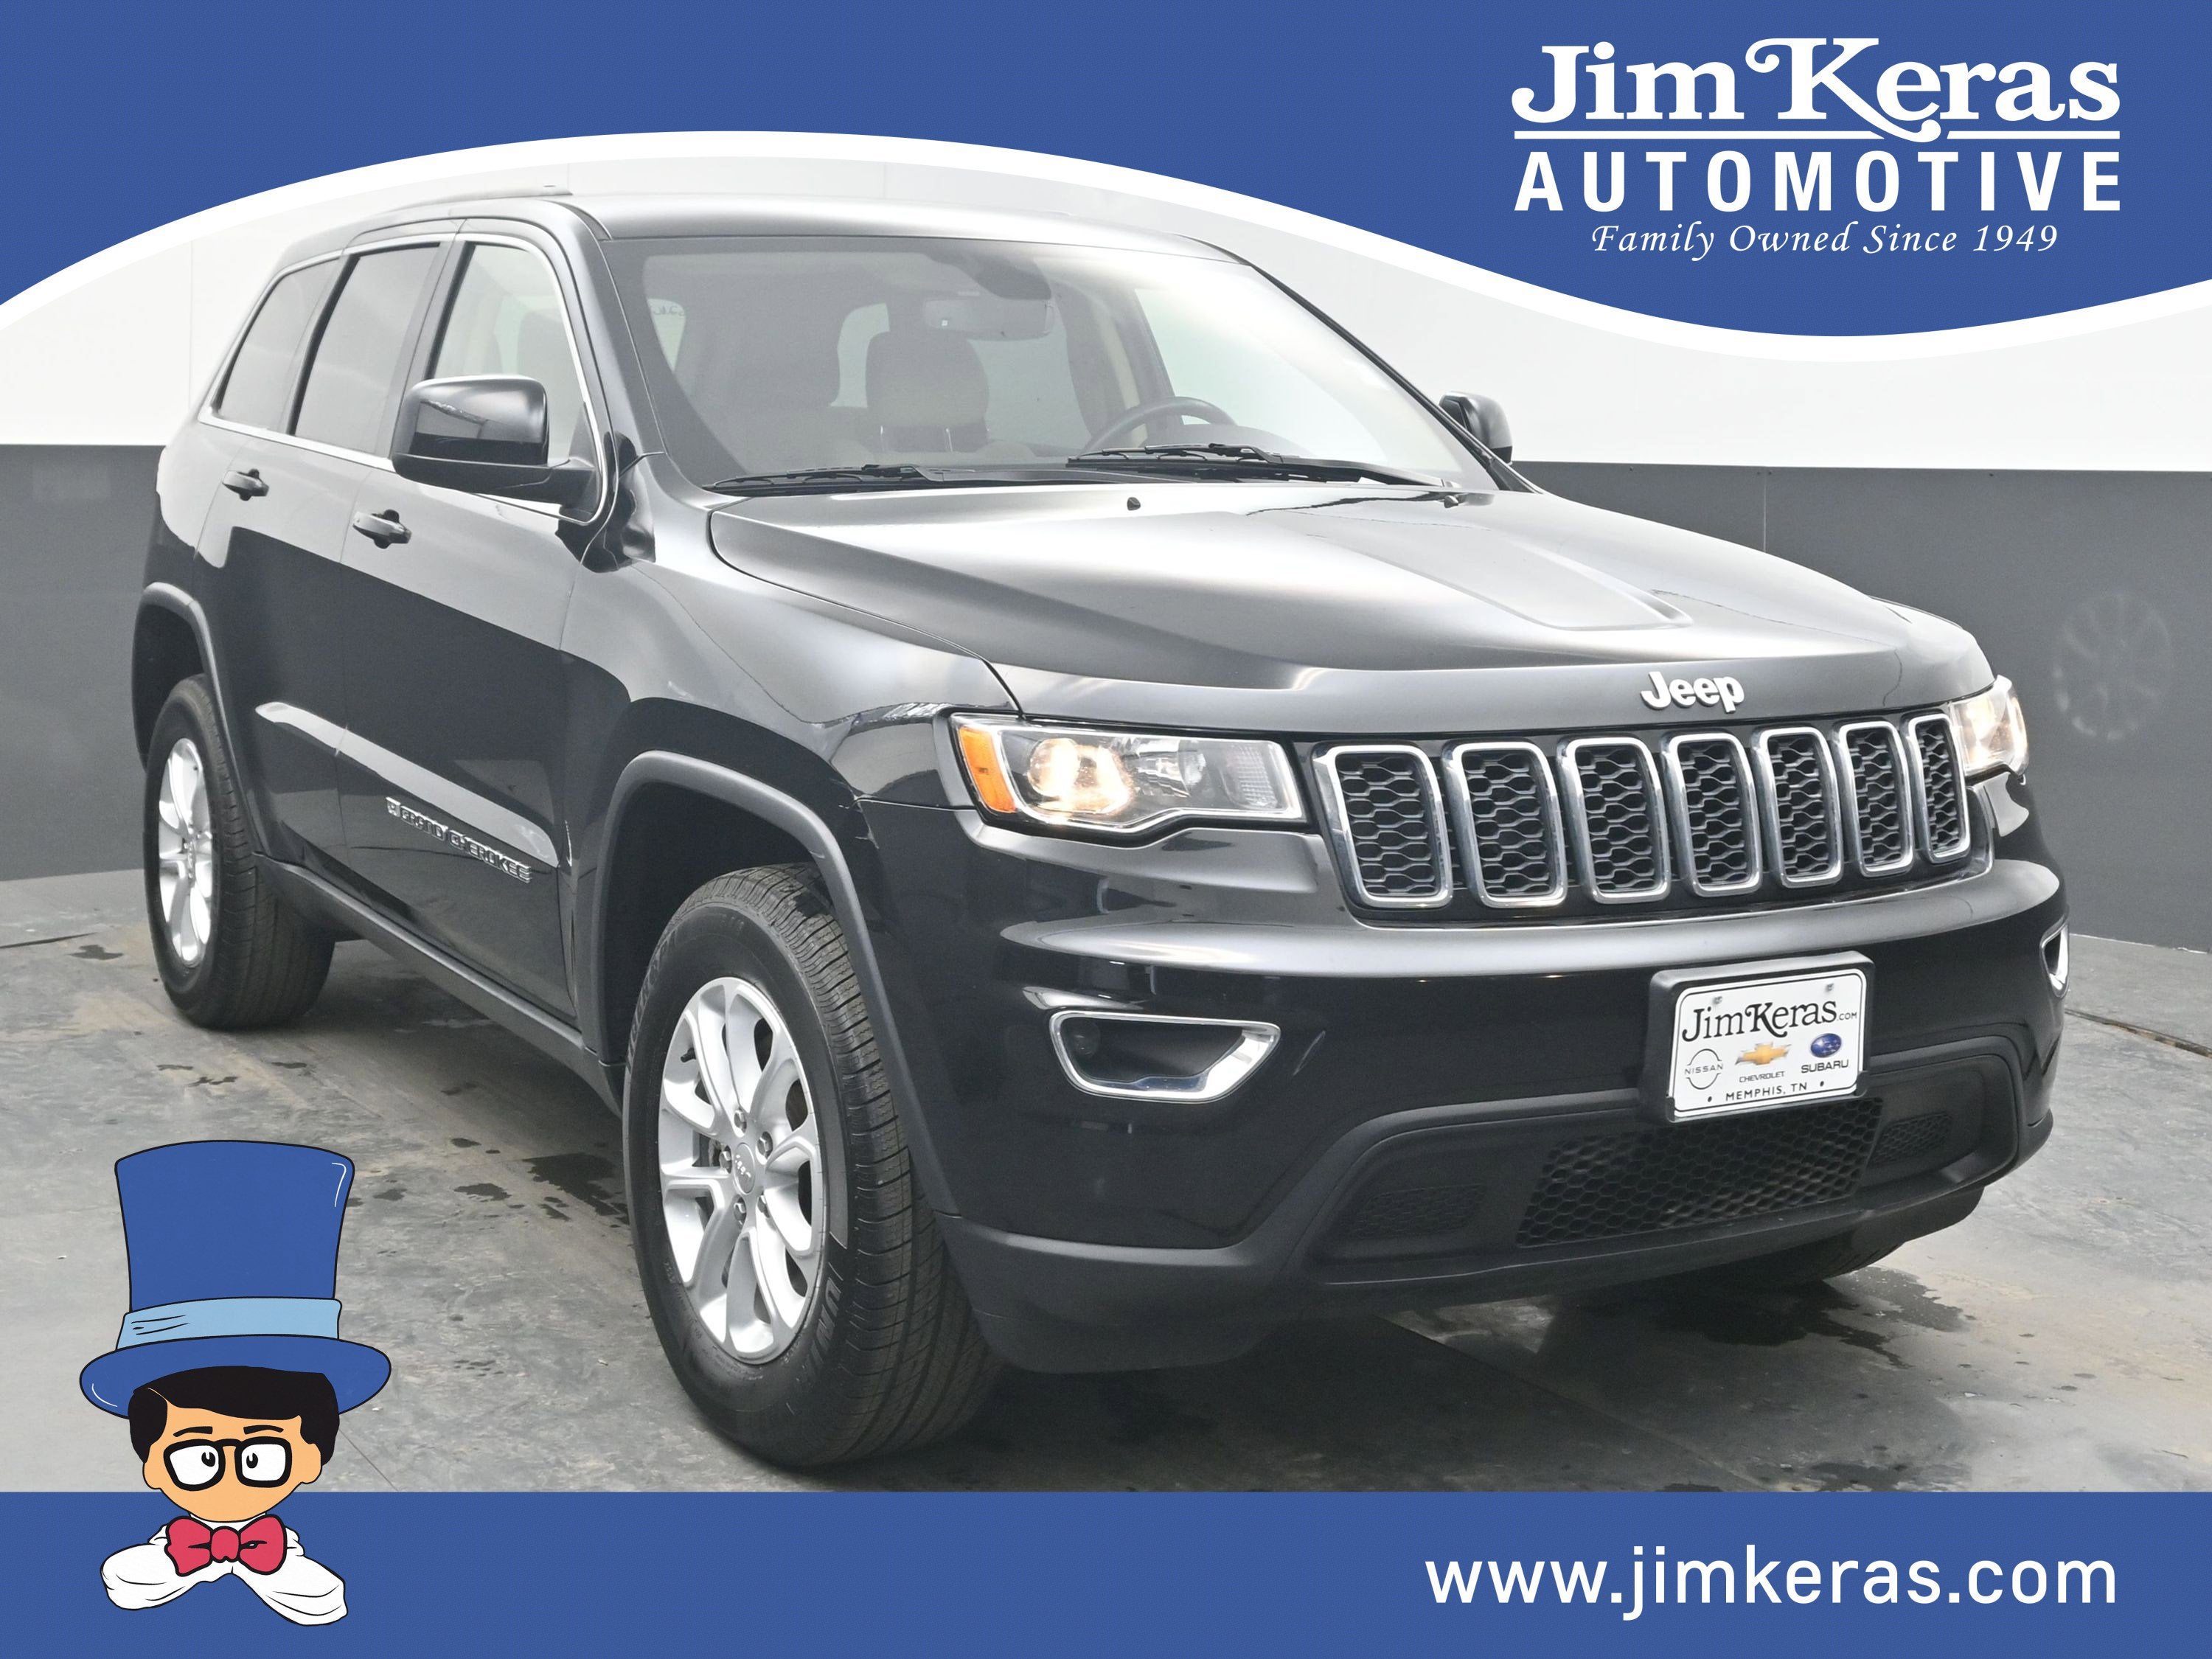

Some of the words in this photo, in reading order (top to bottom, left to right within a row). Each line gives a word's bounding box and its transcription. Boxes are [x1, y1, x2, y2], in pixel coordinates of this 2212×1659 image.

[1640, 671, 1745, 714] Jeep
[1684, 1062, 1724, 1076] NISSAN
[1801, 1060, 1849, 1074] SUBARU
[1739, 1071, 1785, 1083] CHEVROLET
[1725, 1085, 1787, 1102] MEMPHIS,
[1791, 1082, 1808, 1092] TN
